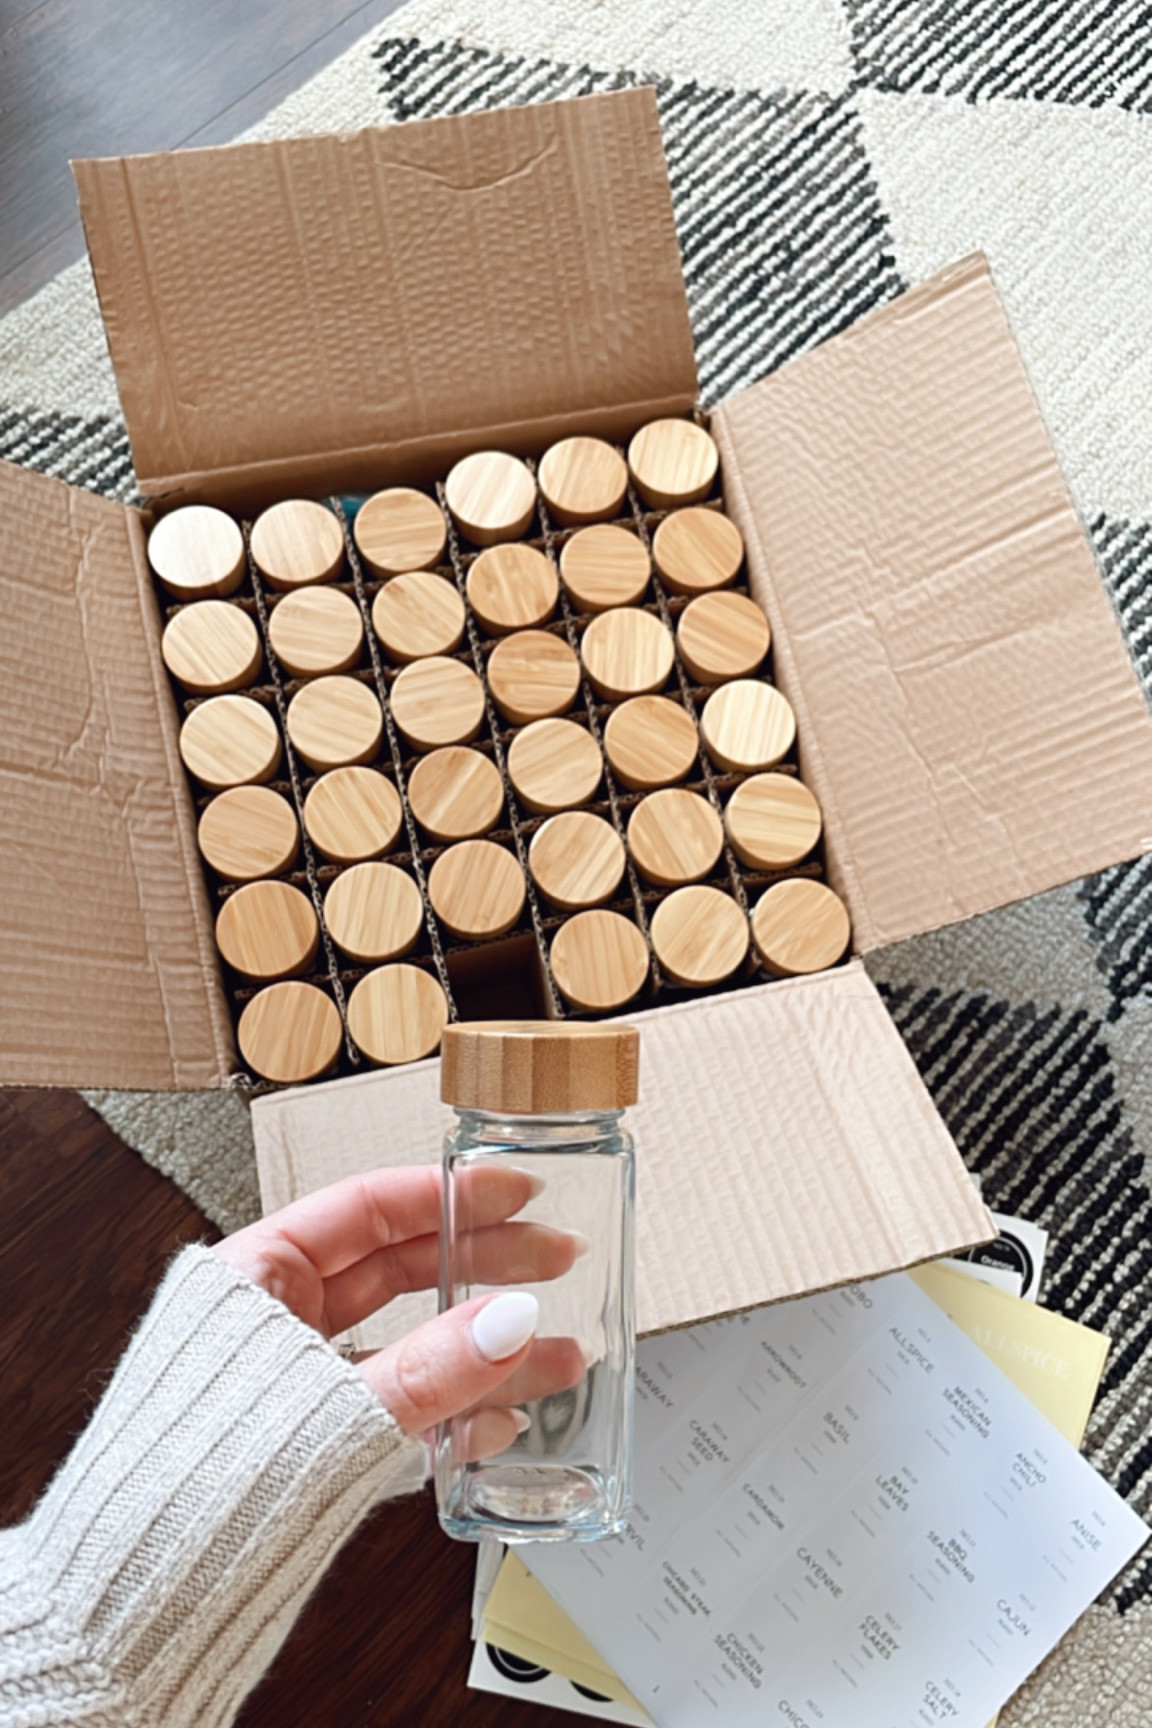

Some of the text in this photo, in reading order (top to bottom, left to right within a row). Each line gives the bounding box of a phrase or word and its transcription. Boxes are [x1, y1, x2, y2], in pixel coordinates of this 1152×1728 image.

[851, 1285, 872, 1309] OBO
[761, 1341, 806, 1389] ARROWROOT
[889, 1327, 934, 1374] ALLSPICE
[635, 1366, 674, 1408] ARAWAY
[942, 1389, 990, 1439] SEASONING
[952, 1386, 991, 1426] MEXICAN
[689, 1420, 729, 1463] CARAWAY
[823, 1412, 851, 1444] BASIL
[691, 1437, 713, 1462] SEED
[1016, 1452, 1046, 1484] ANCHO
[875, 1475, 909, 1511] LEAVES
[890, 1475, 909, 1496] BAY
[1012, 1463, 1036, 1487] CHILI
[743, 1483, 784, 1530] CARDAMOM
[626, 1524, 644, 1551] RVIL
[948, 1539, 968, 1561] BBQ
[1071, 1519, 1102, 1551] ANISE
[797, 1547, 843, 1599] CAYENNE
[927, 1531, 975, 1583] SEASONING
[865, 1614, 899, 1651] CELERY
[996, 1599, 1031, 1636] CAJUN
[726, 1632, 763, 1675] CHICKEN
[859, 1623, 892, 1660] FLAKES
[713, 1634, 762, 1689] SEASONING
[923, 1693, 947, 1719] SALT
[925, 1681, 958, 1716] CELERY
